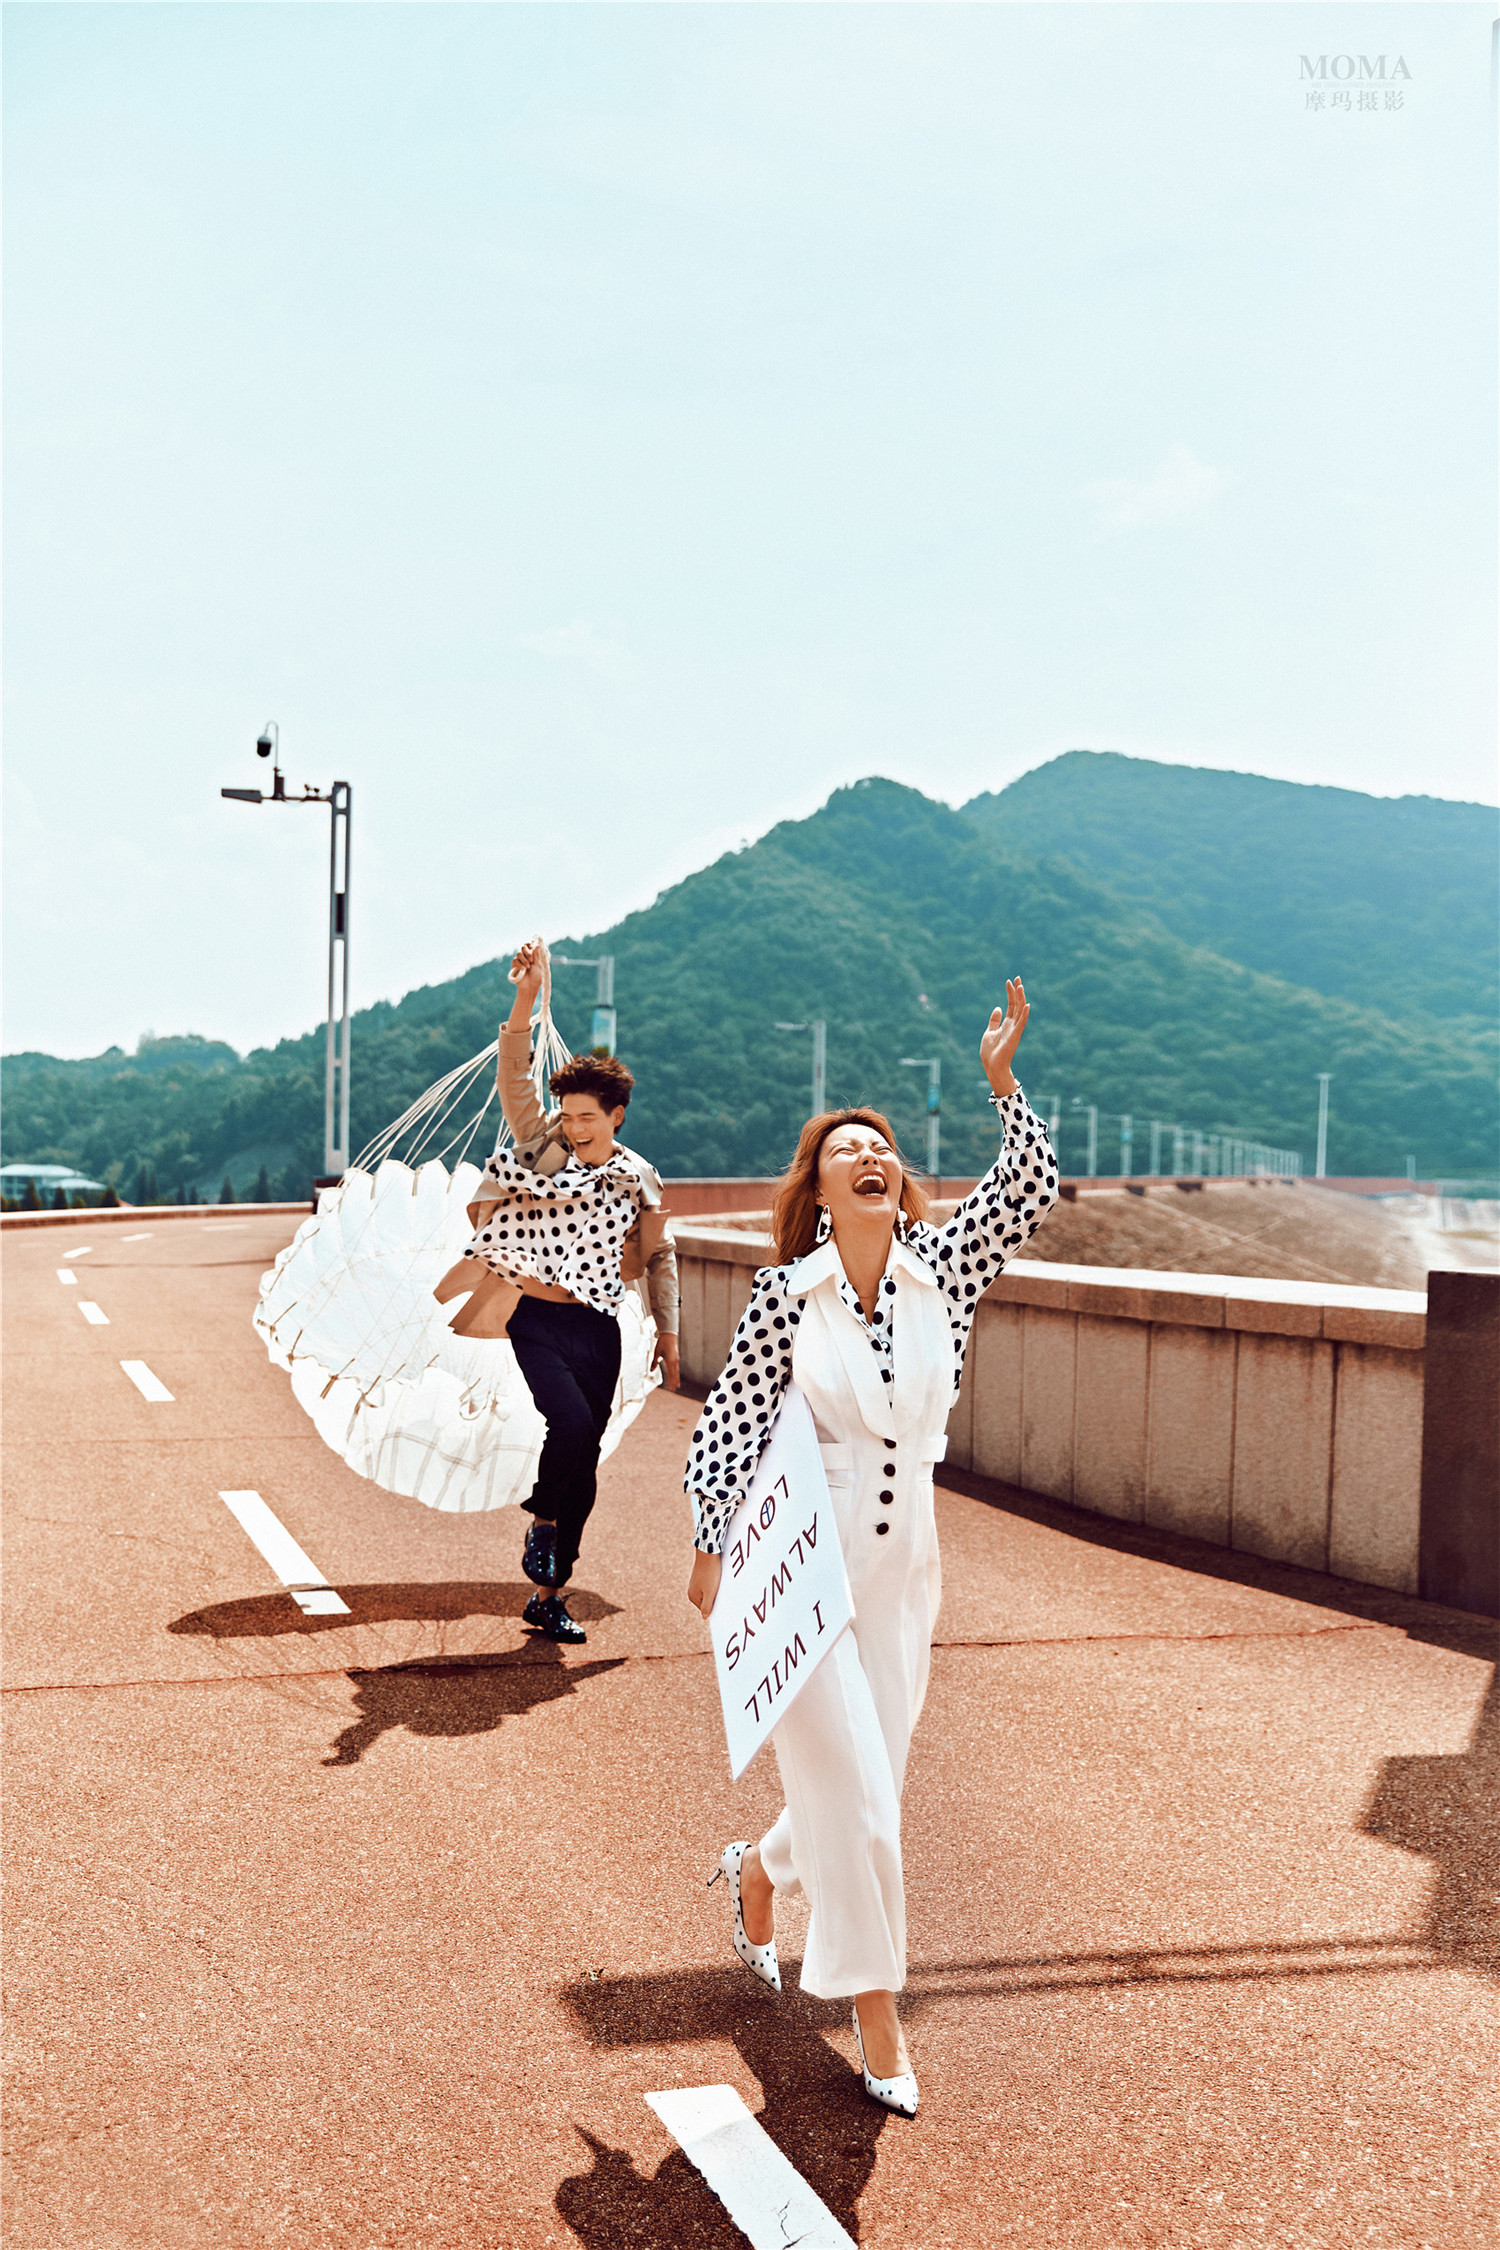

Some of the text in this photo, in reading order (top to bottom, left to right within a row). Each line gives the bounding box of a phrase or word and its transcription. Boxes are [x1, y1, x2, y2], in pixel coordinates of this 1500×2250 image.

[730, 1474, 790, 1578] LOVE
[725, 1511, 818, 1671] ALWAYS
[744, 1600, 826, 1723] I WILL
